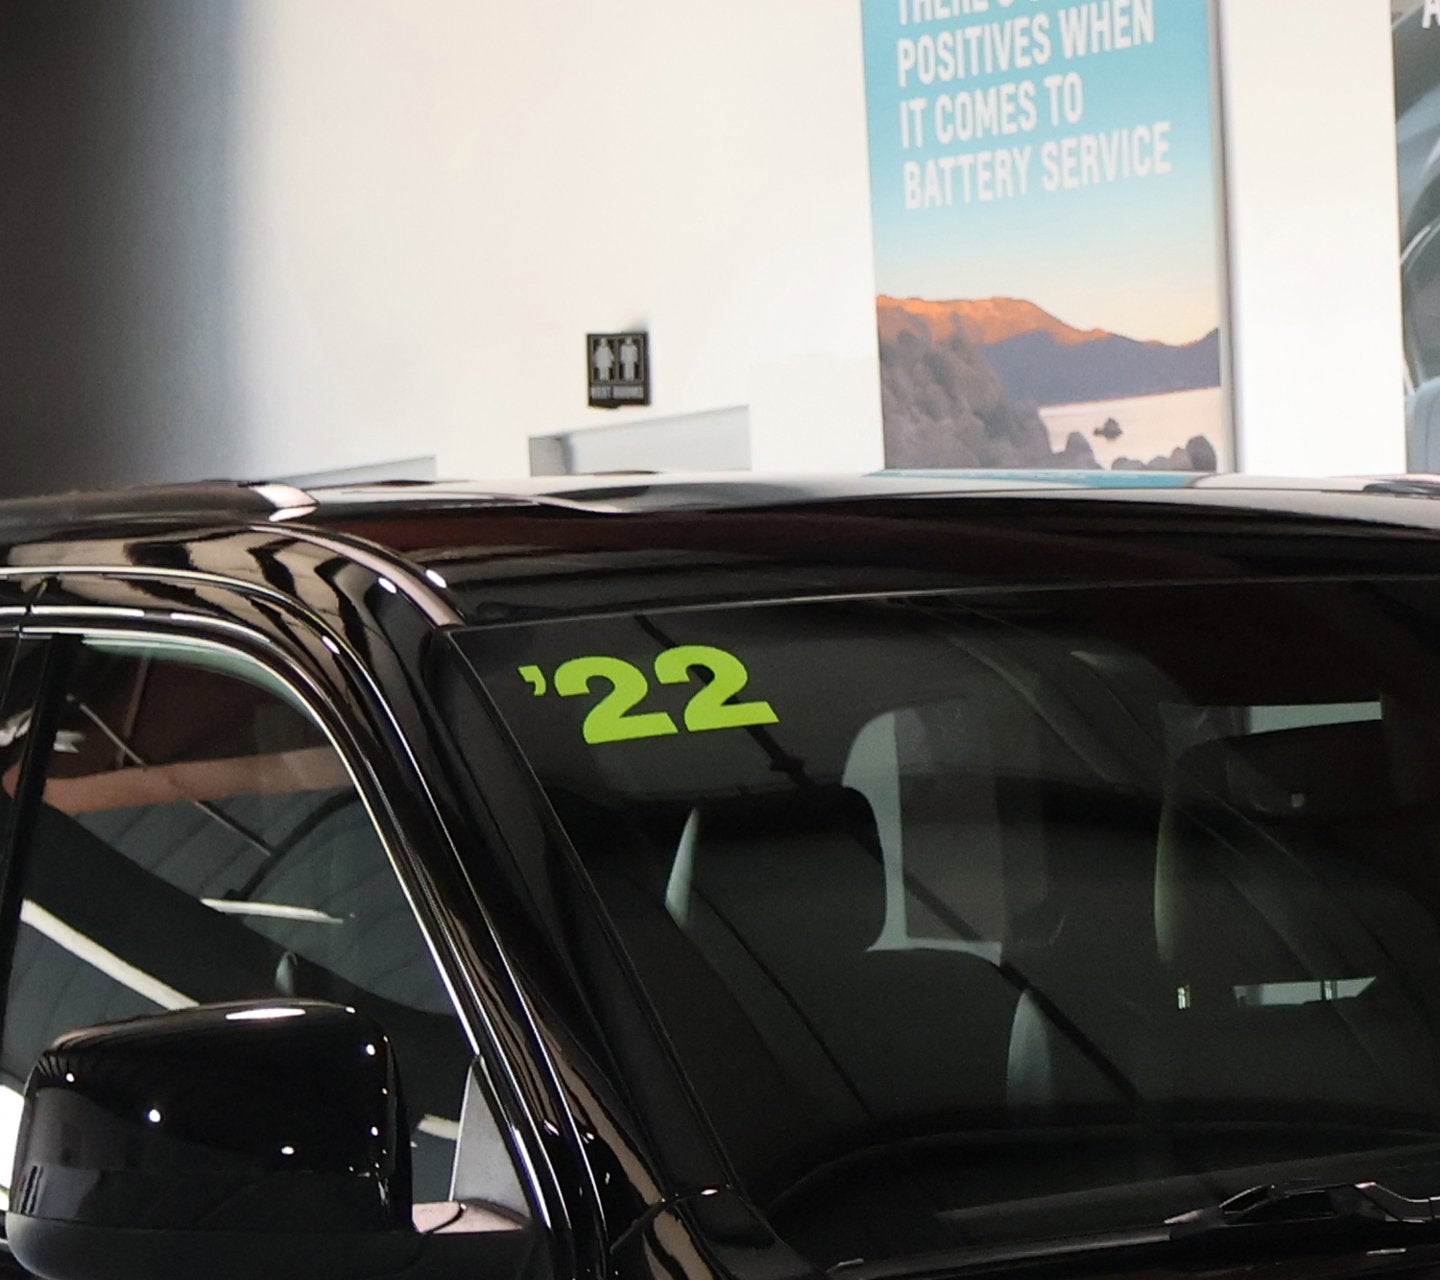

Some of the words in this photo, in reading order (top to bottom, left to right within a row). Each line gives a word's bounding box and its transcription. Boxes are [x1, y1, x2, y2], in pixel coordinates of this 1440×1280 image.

[897, 13, 1052, 88] POSITIVES
[1058, 0, 1155, 59] WHEN
[900, 98, 928, 149] IT
[934, 80, 1038, 144] COMES
[1044, 71, 1085, 126] TO
[903, 145, 1033, 210] BATTERY
[1041, 121, 1173, 192] SERVICE
